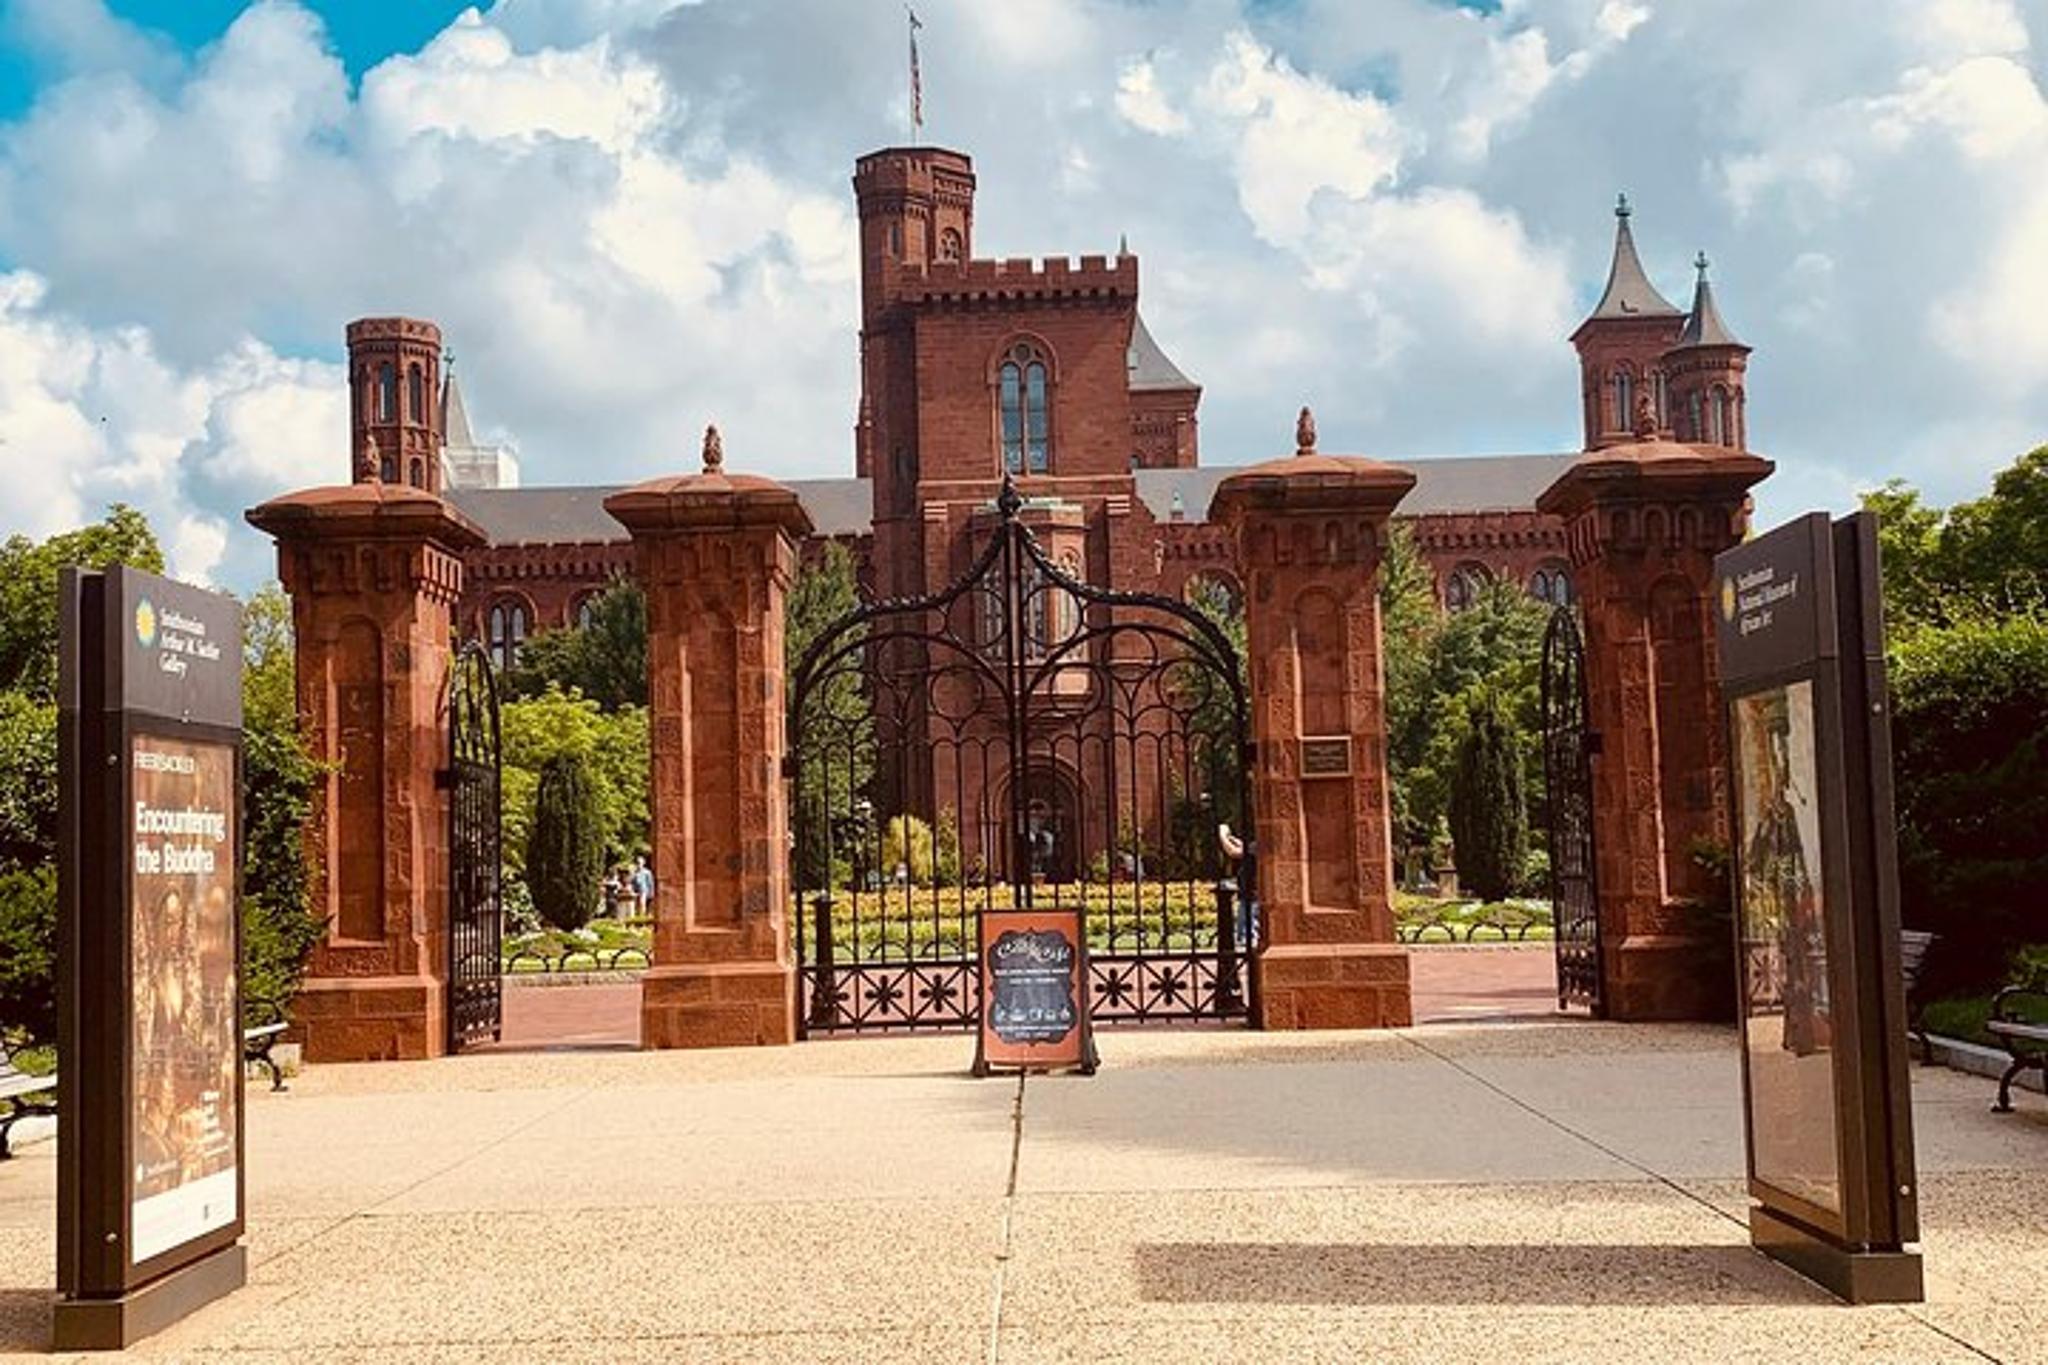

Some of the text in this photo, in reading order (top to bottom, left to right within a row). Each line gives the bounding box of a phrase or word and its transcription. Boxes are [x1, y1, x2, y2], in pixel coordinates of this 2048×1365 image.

[136, 801, 225, 842] Encountering
[136, 842, 214, 874] the Buddha
